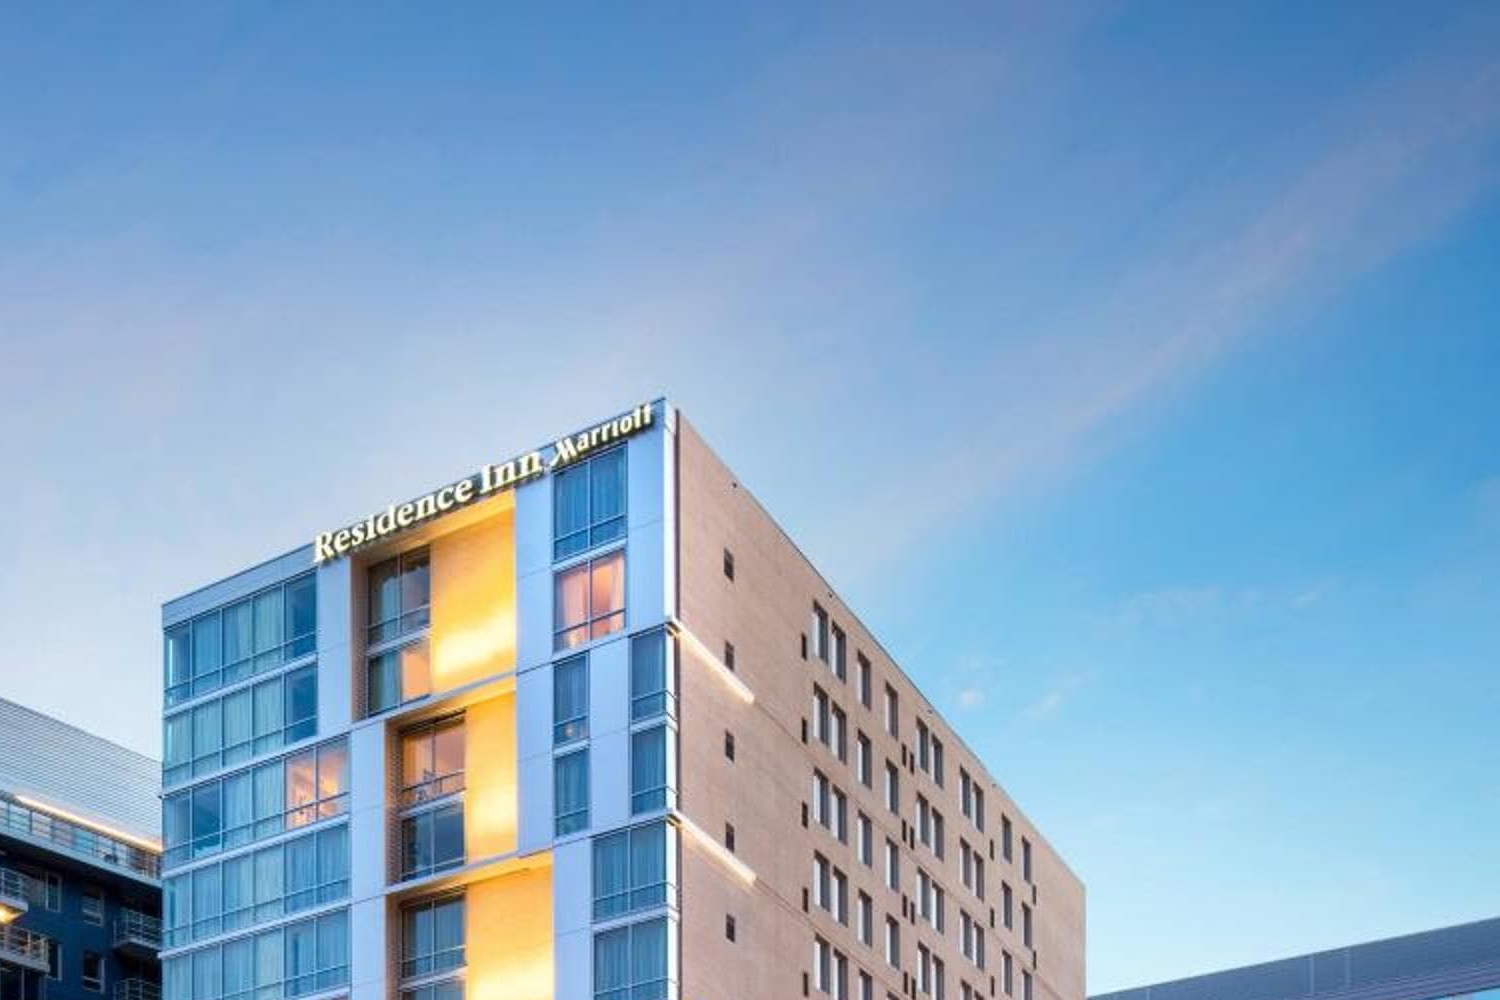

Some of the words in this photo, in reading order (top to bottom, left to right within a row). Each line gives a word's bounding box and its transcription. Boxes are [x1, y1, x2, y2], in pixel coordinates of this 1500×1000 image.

[313, 481, 474, 563] Residence
[478, 450, 543, 494] Inn
[550, 402, 654, 467] Marriott
